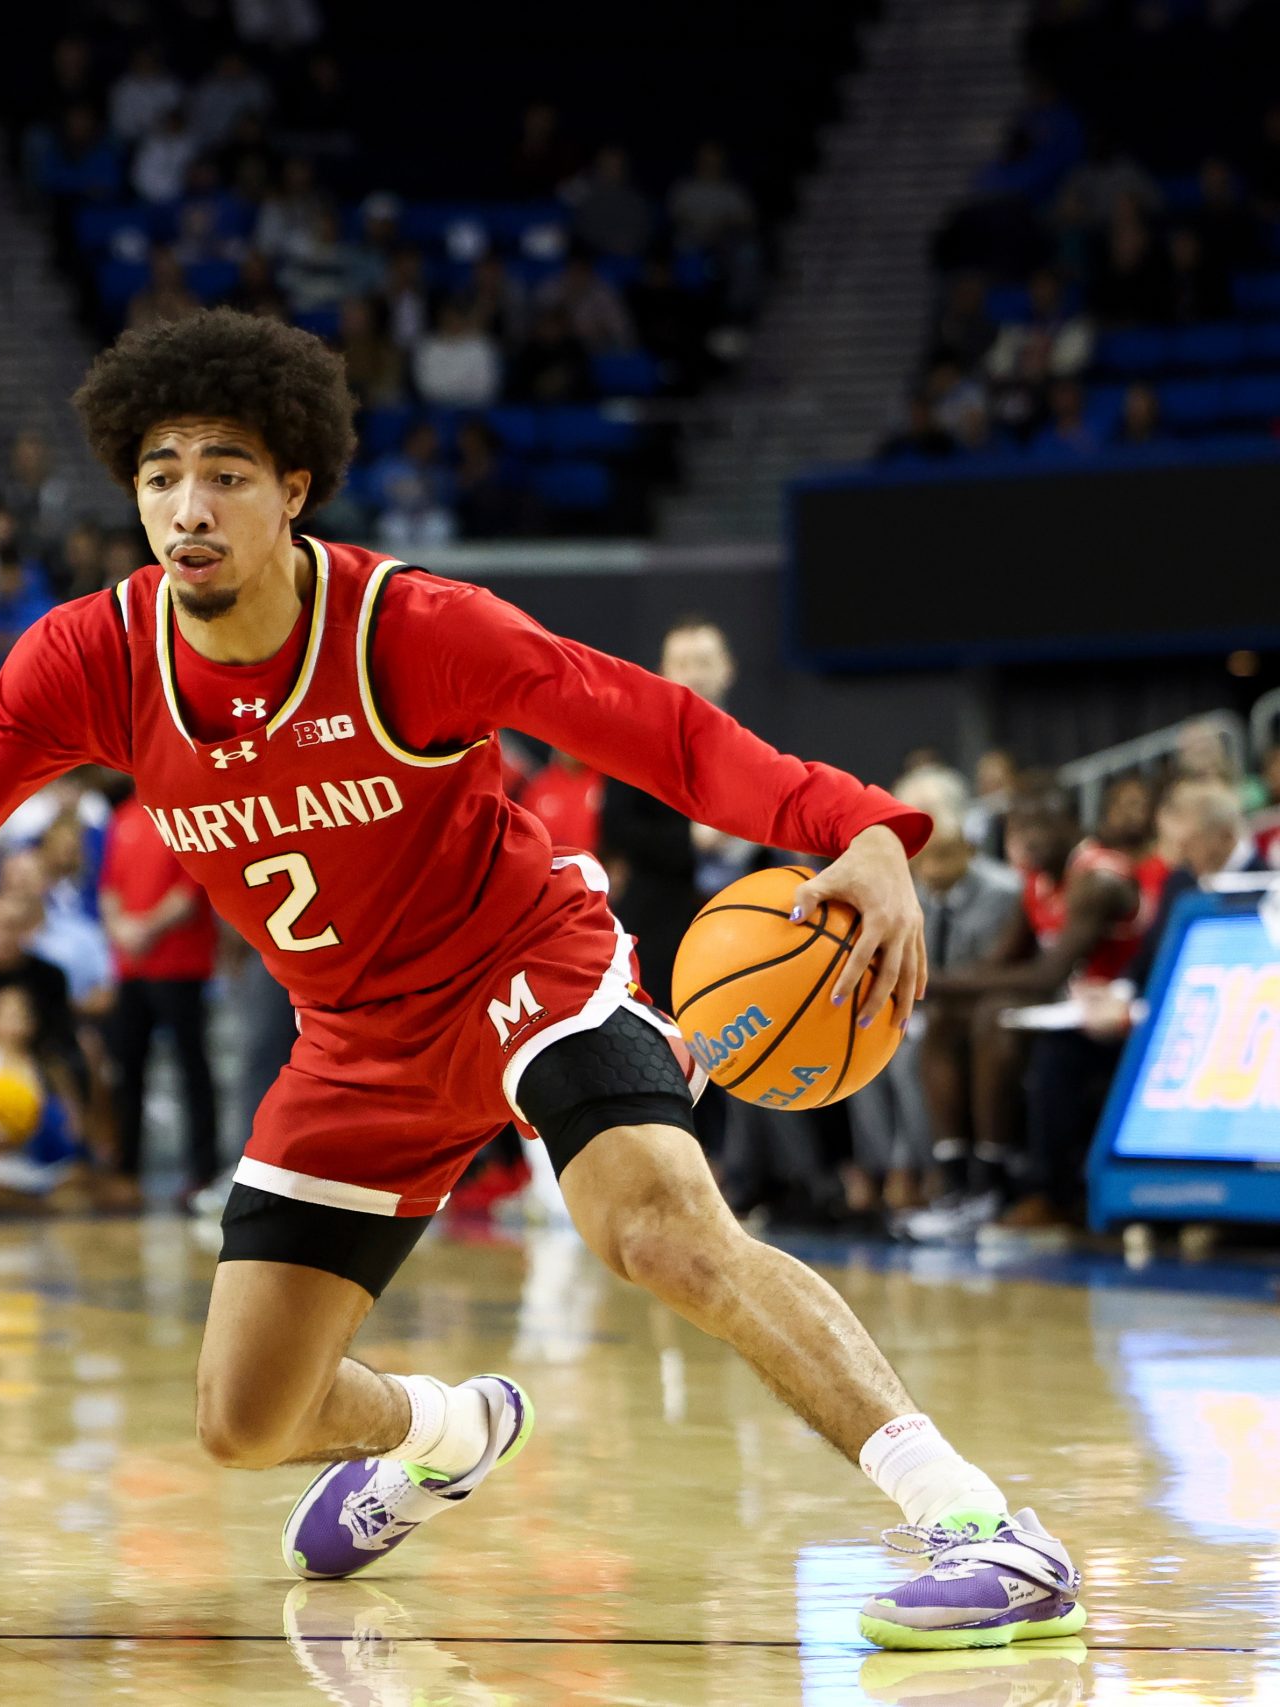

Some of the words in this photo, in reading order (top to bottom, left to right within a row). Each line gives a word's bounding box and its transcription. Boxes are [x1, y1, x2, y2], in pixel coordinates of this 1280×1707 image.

[143, 775, 404, 853] MARYLAND
[243, 851, 342, 952] 2
[486, 969, 545, 1048] M
[686, 1004, 773, 1075] ilson
[756, 1065, 832, 1107] CLA
